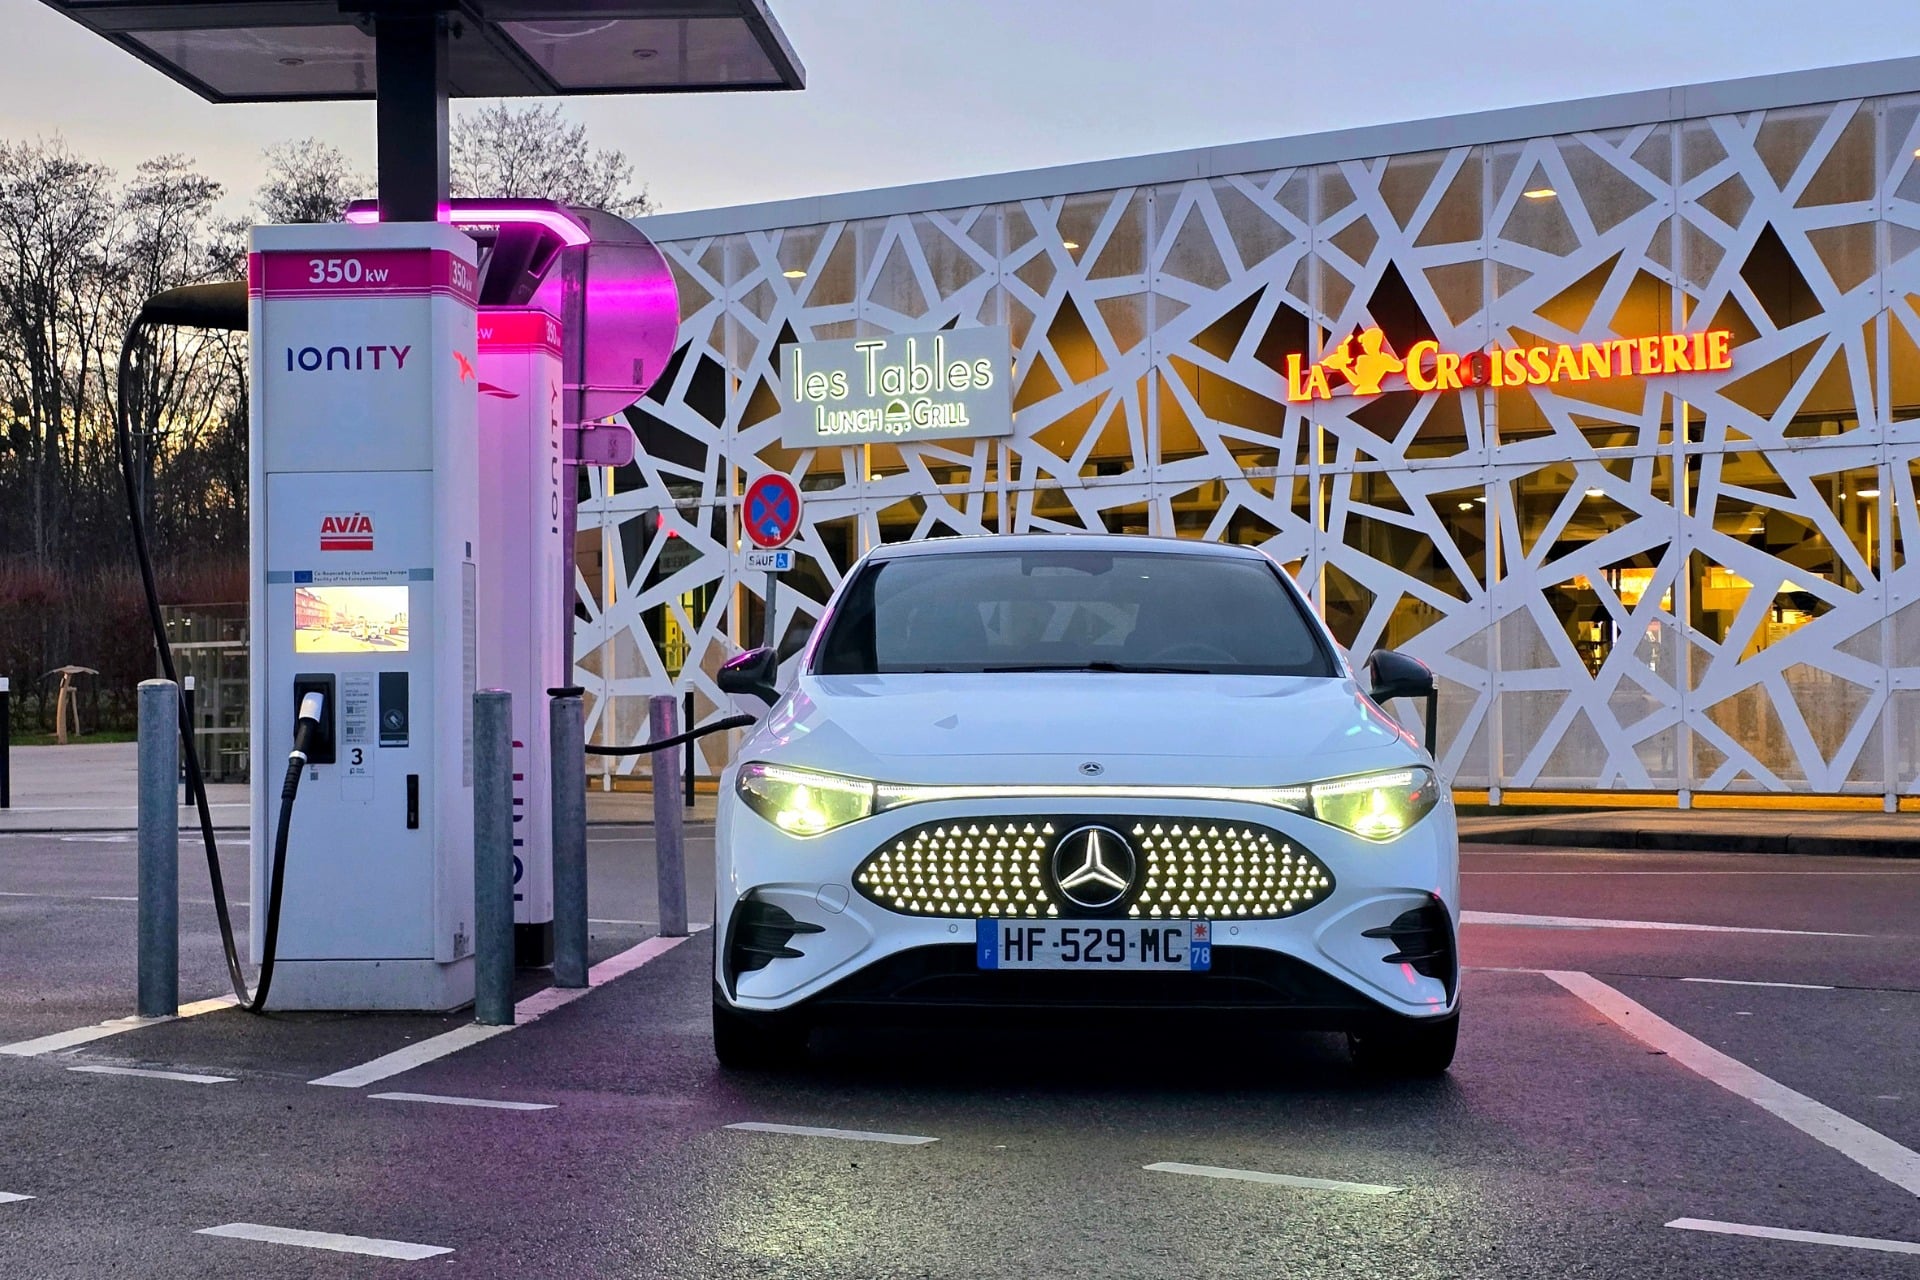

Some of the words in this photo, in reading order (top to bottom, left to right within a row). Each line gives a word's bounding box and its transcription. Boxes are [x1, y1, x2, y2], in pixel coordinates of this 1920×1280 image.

[309, 258, 362, 283] 350
[365, 268, 389, 282] kW
[452, 260, 467, 289] 350
[287, 345, 412, 371] IONITY
[794, 348, 848, 402] les
[855, 335, 994, 397] Tables
[1287, 353, 1331, 401] LA
[1405, 330, 1732, 391] CROISSANTERIE
[816, 403, 884, 436] LUNCH
[912, 397, 970, 429] GRILL
[749, 555, 775, 567] SAUF
[351, 748, 363, 765] 3
[984, 949, 991, 960] F
[1191, 947, 1210, 964] 78
